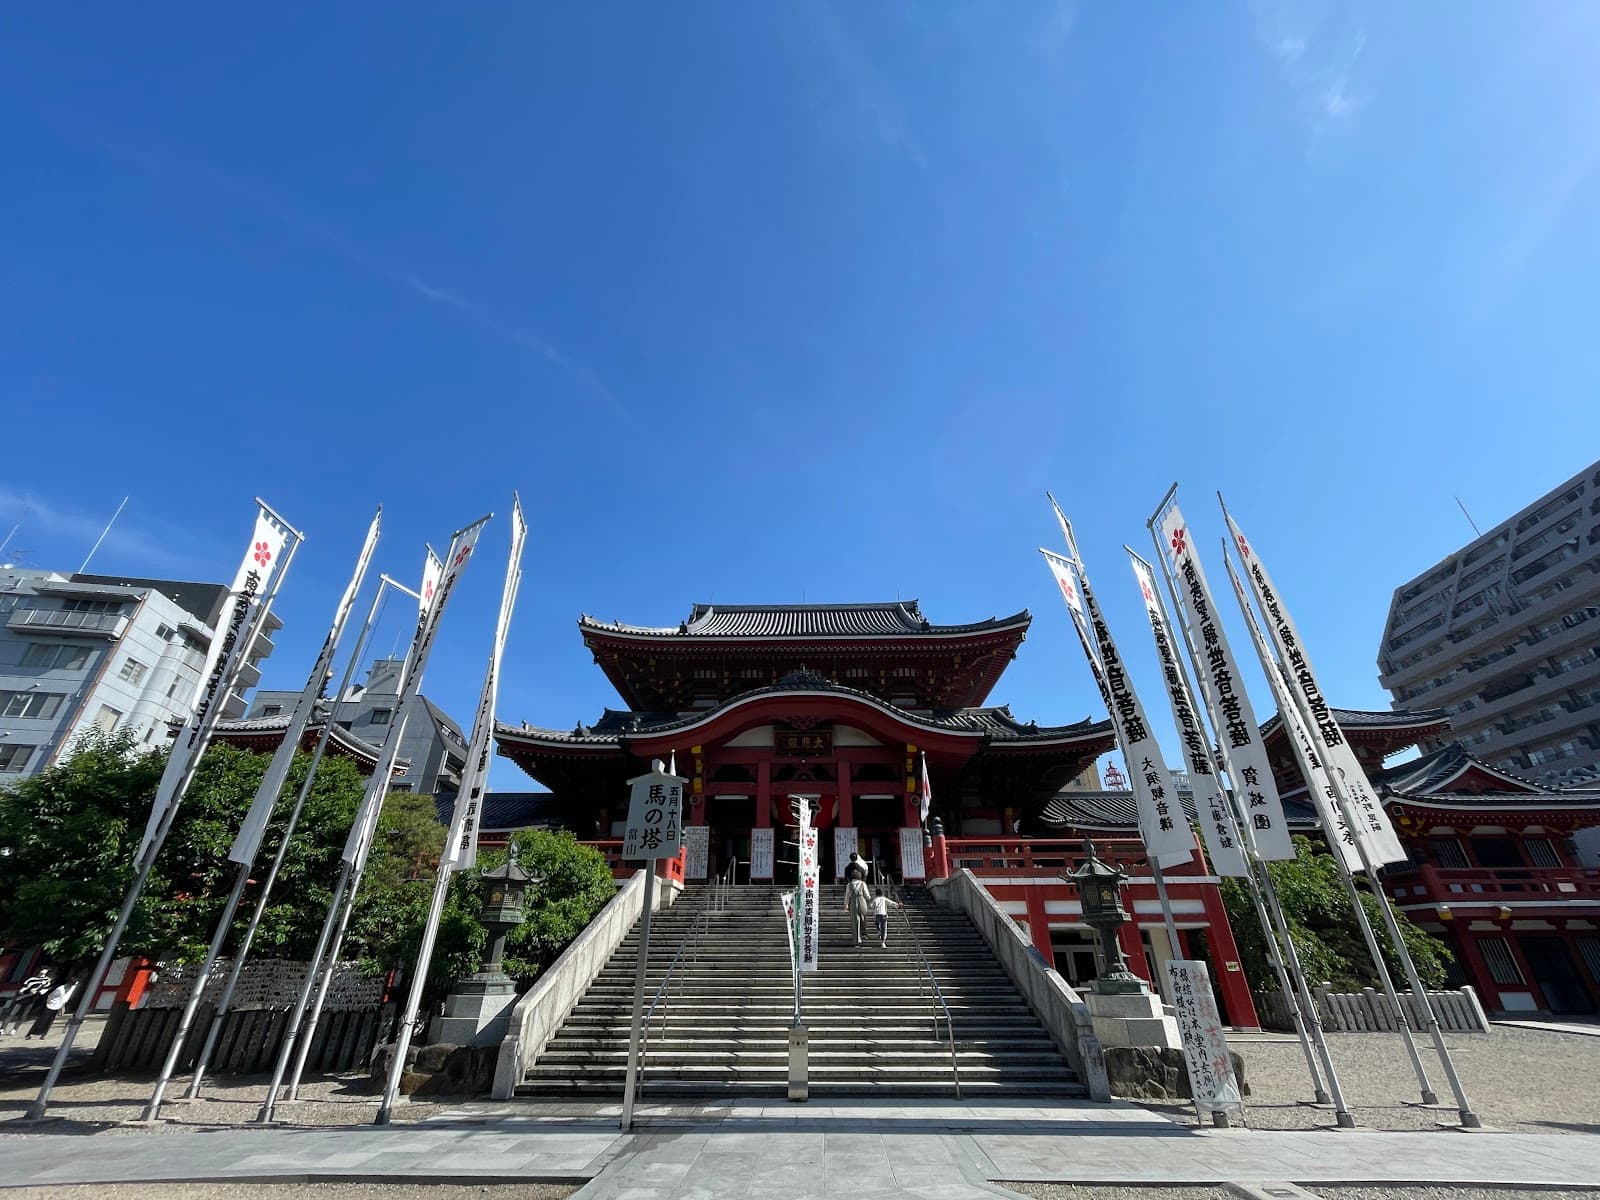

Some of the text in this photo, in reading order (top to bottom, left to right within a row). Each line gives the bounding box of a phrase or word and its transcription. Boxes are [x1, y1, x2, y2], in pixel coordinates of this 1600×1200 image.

[640, 784, 667, 850] 馬の塔
[666, 786, 680, 841] 五月十八日
